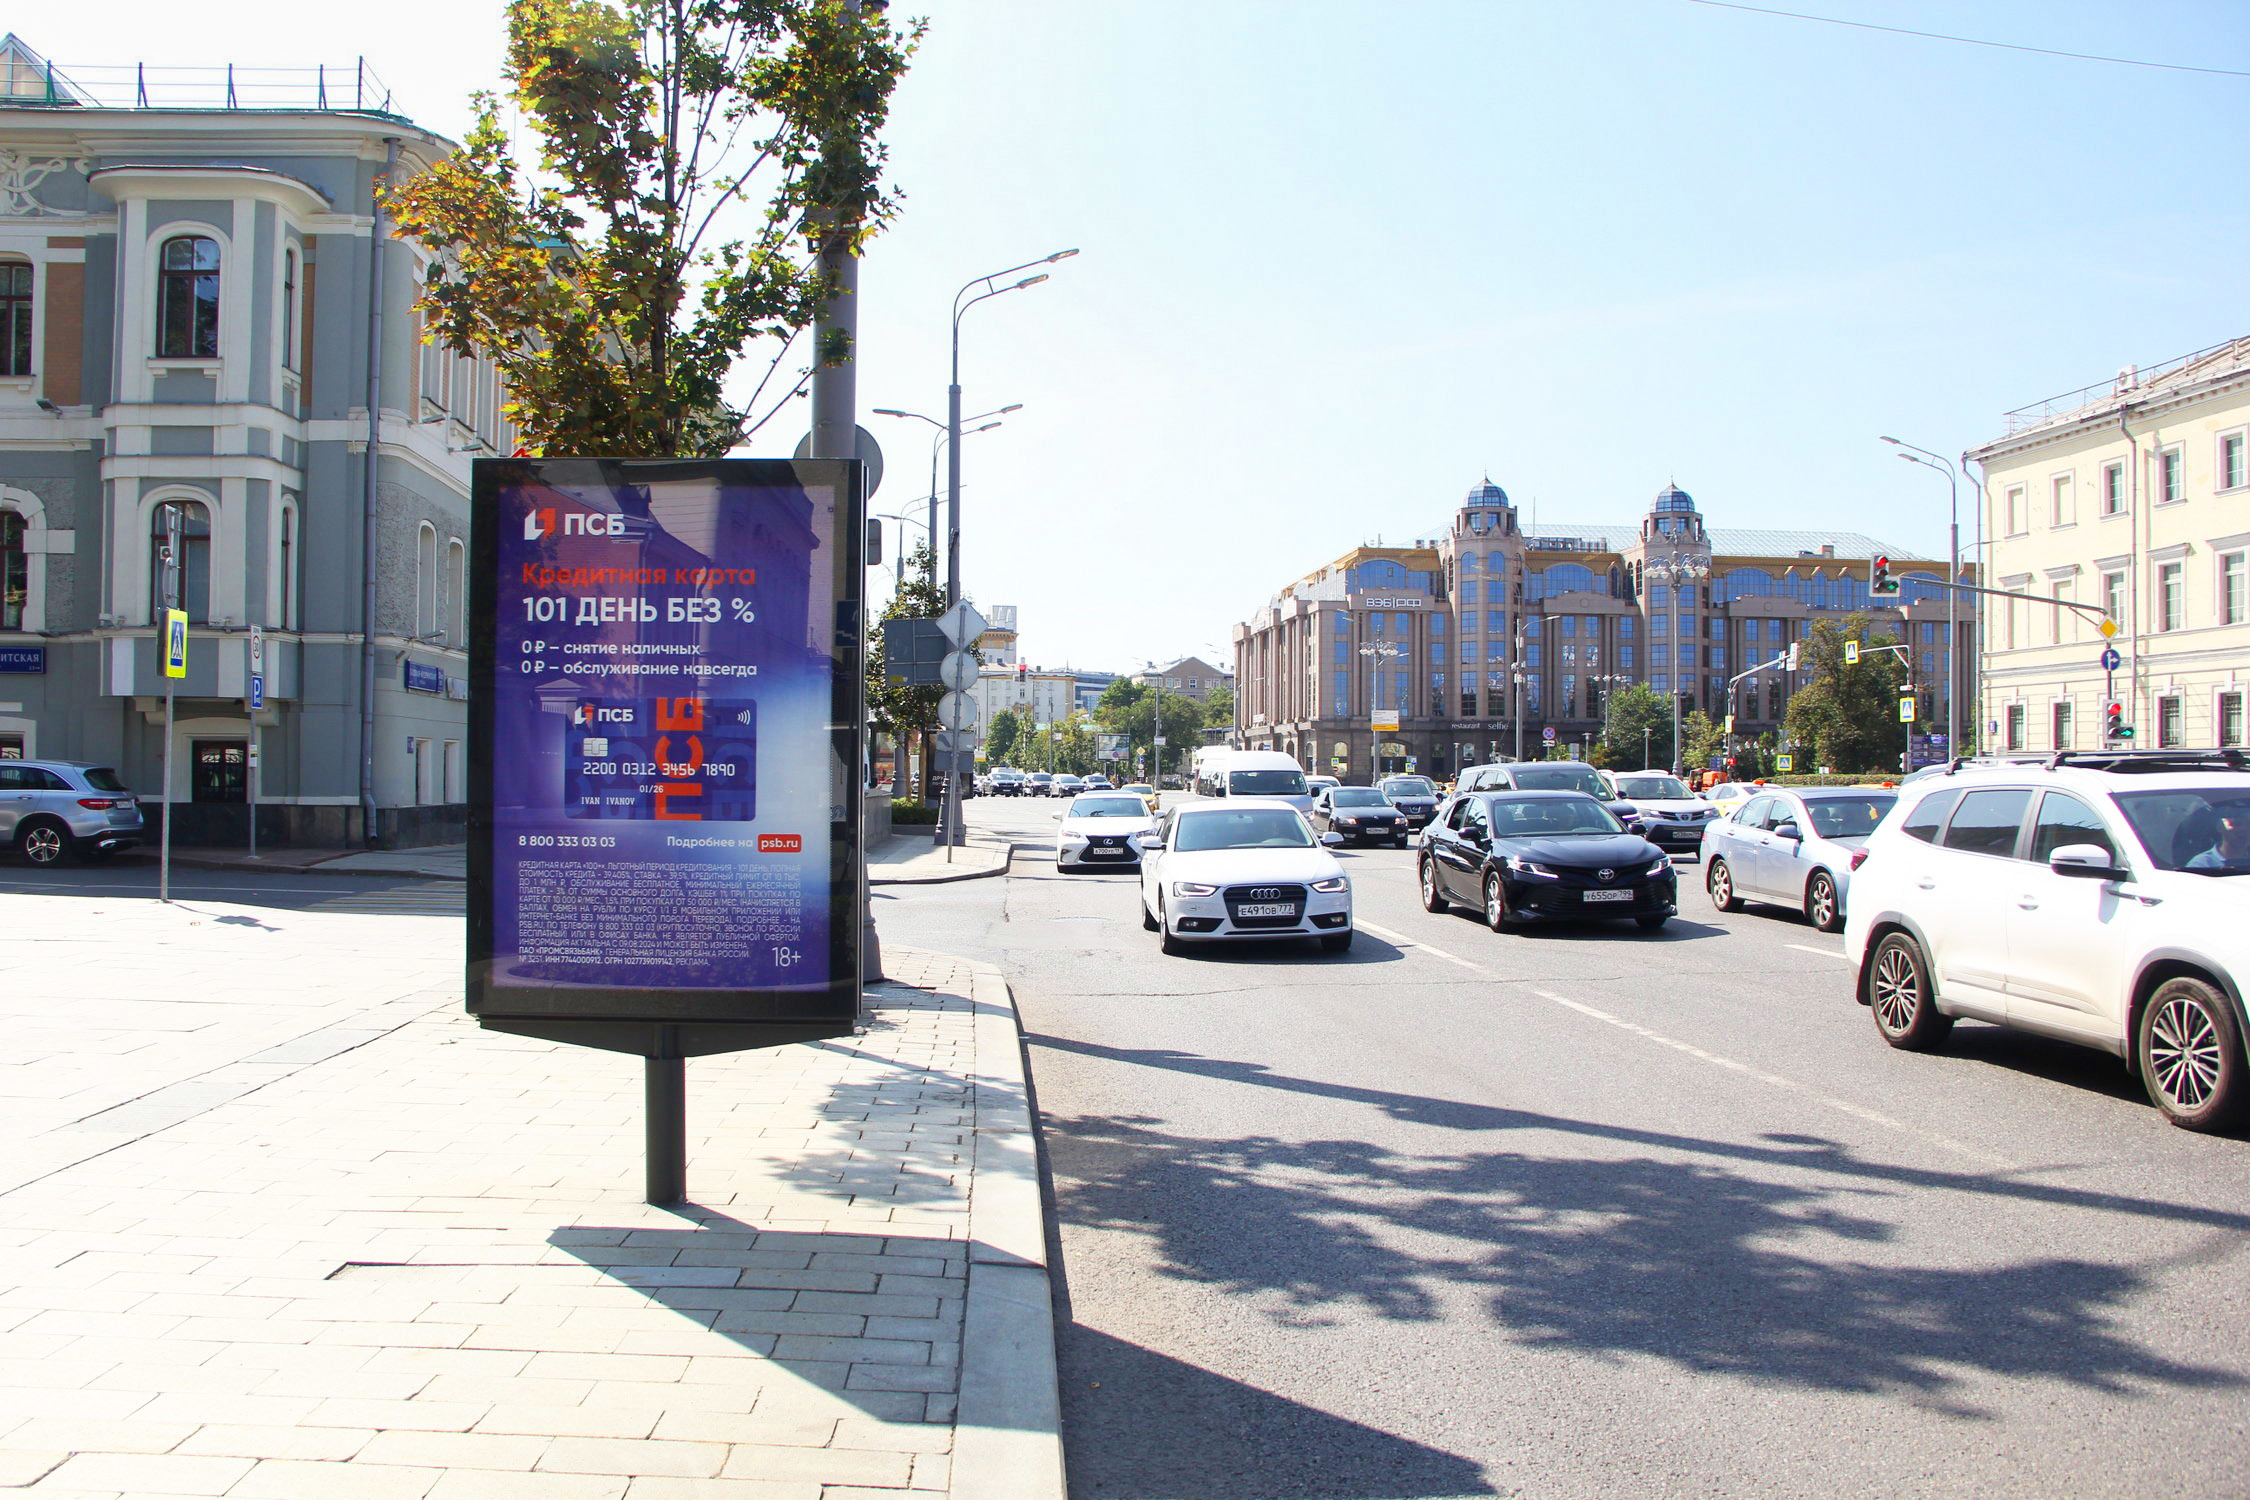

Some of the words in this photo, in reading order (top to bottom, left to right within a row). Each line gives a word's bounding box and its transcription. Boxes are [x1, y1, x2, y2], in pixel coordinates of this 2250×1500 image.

[564, 513, 626, 536] ПСБ
[522, 562, 666, 589] Кредитная
[676, 568, 757, 590] карта
[522, 597, 567, 622] 101
[575, 597, 658, 626] ДЕНЬ
[667, 597, 722, 623] БЕЗ
[731, 597, 755, 623] %
[563, 643, 617, 655] снятие
[622, 643, 701, 655] наличных
[563, 661, 679, 677] обслуживание
[684, 664, 757, 678] навсегда
[597, 708, 634, 723] ПСБ
[583, 762, 617, 775] 2200
[622, 762, 656, 776] 0312
[661, 763, 696, 776] 3456
[702, 763, 736, 777] 7890
[639, 784, 664, 794] 01/26
[581, 796, 601, 805] IVAN
[606, 797, 635, 806] IVANOV
[518, 835, 527, 846] 8
[529, 835, 554, 846] 800
[557, 836, 578, 847] 333
[581, 836, 597, 847] 03
[600, 836, 616, 848] 03
[667, 836, 735, 849] Подробнее
[738, 839, 753, 848] на
[761, 838, 798, 850] psb.ru
[771, 946, 802, 968] 18+
